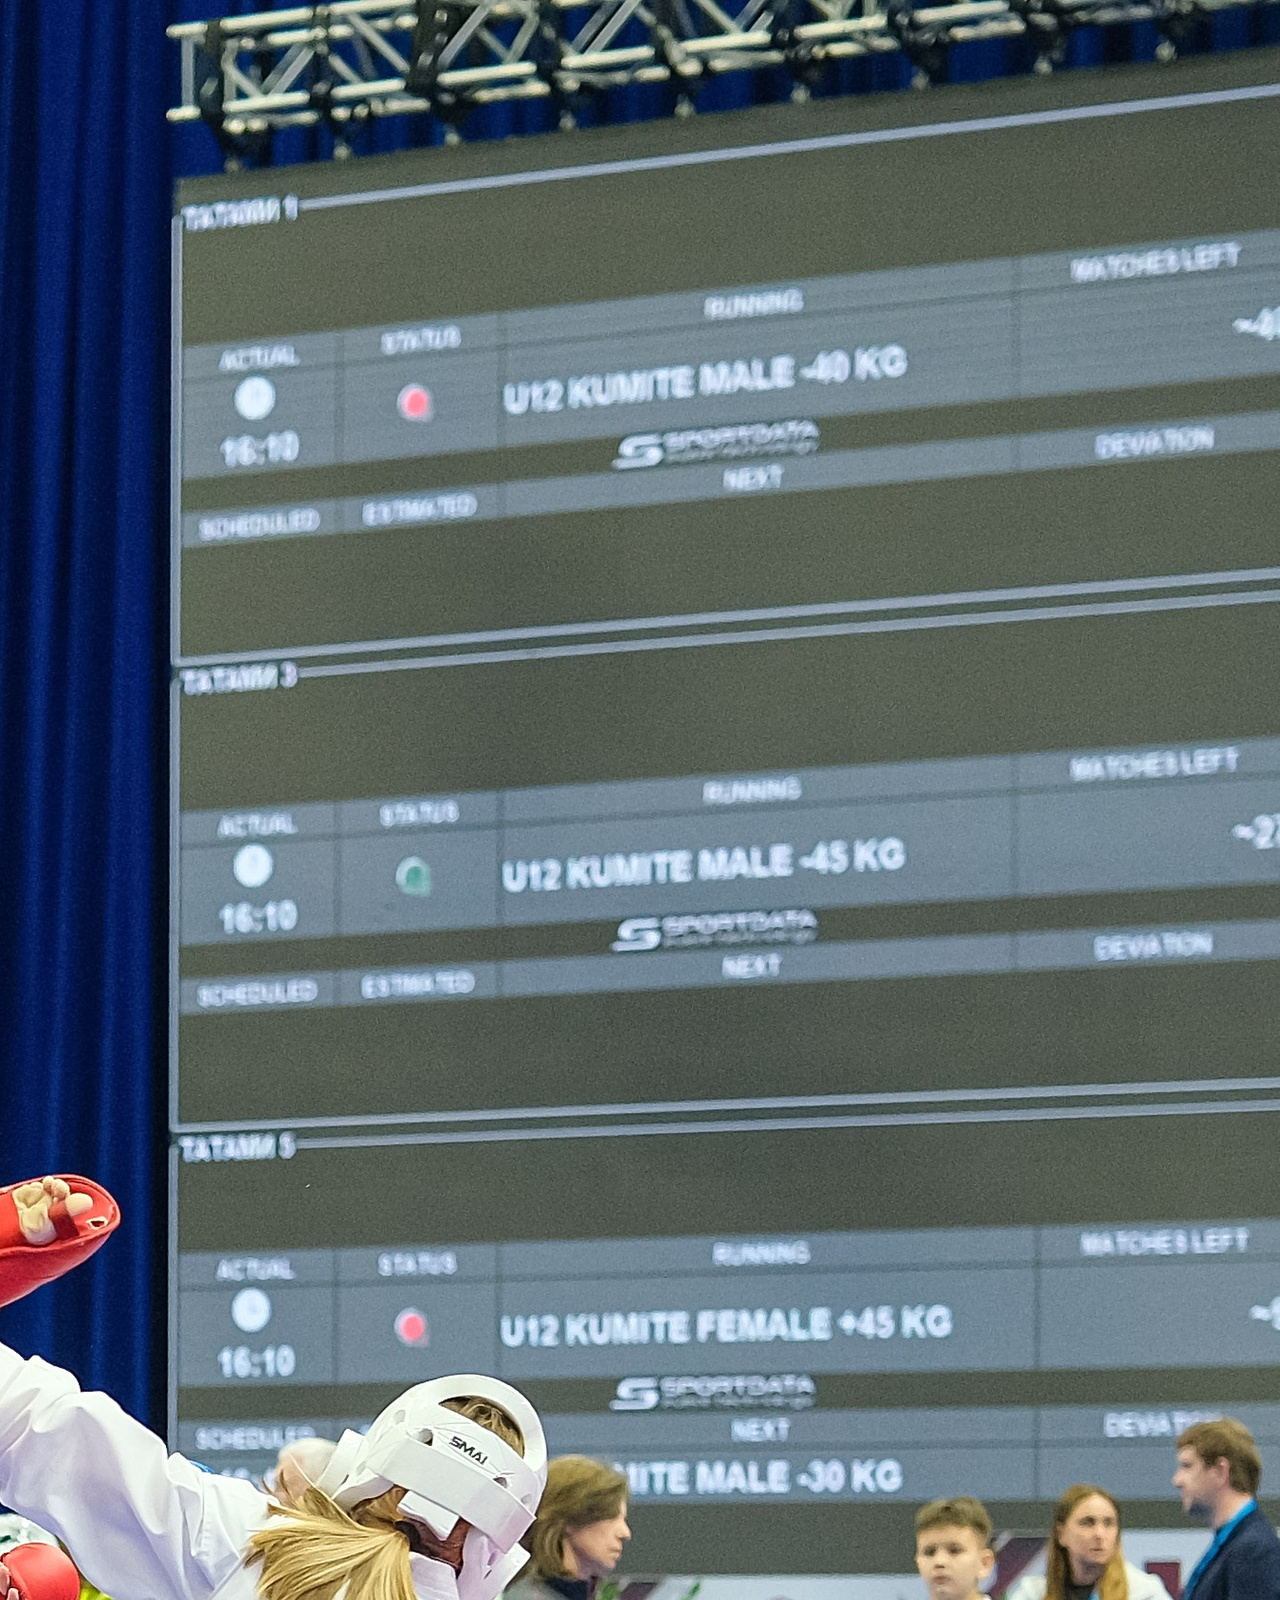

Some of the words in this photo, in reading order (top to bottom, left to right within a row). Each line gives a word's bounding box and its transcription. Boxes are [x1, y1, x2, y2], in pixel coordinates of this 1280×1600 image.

[1070, 249, 1182, 282] MATCHES
[1183, 241, 1241, 272] LEFT
[704, 288, 805, 320] RUNNING
[380, 325, 462, 355] STATUS
[219, 345, 300, 371] ACTUAL
[503, 379, 564, 415] U12
[568, 365, 695, 408] KUMITE
[699, 354, 795, 395] MALE
[800, 349, 851, 384] -40
[854, 344, 908, 380] KG
[220, 430, 300, 467] 16:10
[1095, 427, 1215, 459] DEVIATION
[723, 464, 784, 492] NEXT
[198, 508, 321, 541] SCHEDULED
[362, 493, 478, 526] ESTIMATED
[1070, 750, 1179, 782] MATCHES
[1180, 746, 1239, 775] LEFT
[703, 776, 803, 804] RUNNING
[218, 813, 298, 838] ACTUAL
[379, 799, 460, 828] STATUS
[502, 859, 563, 893] U12
[567, 850, 693, 888] KUMITE
[698, 843, 794, 881] MALE
[799, 840, 849, 875] -45
[853, 836, 907, 872] KG
[220, 899, 298, 934] 16:10
[1094, 931, 1214, 961] DEVIATION
[722, 953, 783, 979] NEXT
[197, 979, 318, 1008] SCHEDULED
[361, 970, 475, 999] ESTIMATED
[712, 1240, 811, 1266] RUNNING
[1080, 1228, 1188, 1256] MATCHES
[1190, 1226, 1250, 1254] LEFT
[216, 1257, 296, 1282] ACTUAL
[377, 1251, 458, 1276] STATUS
[501, 1314, 560, 1347] U12
[565, 1310, 691, 1345] KUMITE
[697, 1306, 832, 1342] FEMALE
[837, 1305, 895, 1339] +45
[901, 1303, 954, 1338] KG
[218, 1344, 296, 1378] 16:10
[730, 1417, 791, 1442] NEXT
[449, 1435, 488, 1466] SMAI
[695, 1459, 791, 1494] MALE
[797, 1459, 846, 1493] -30
[851, 1458, 904, 1492] KG
